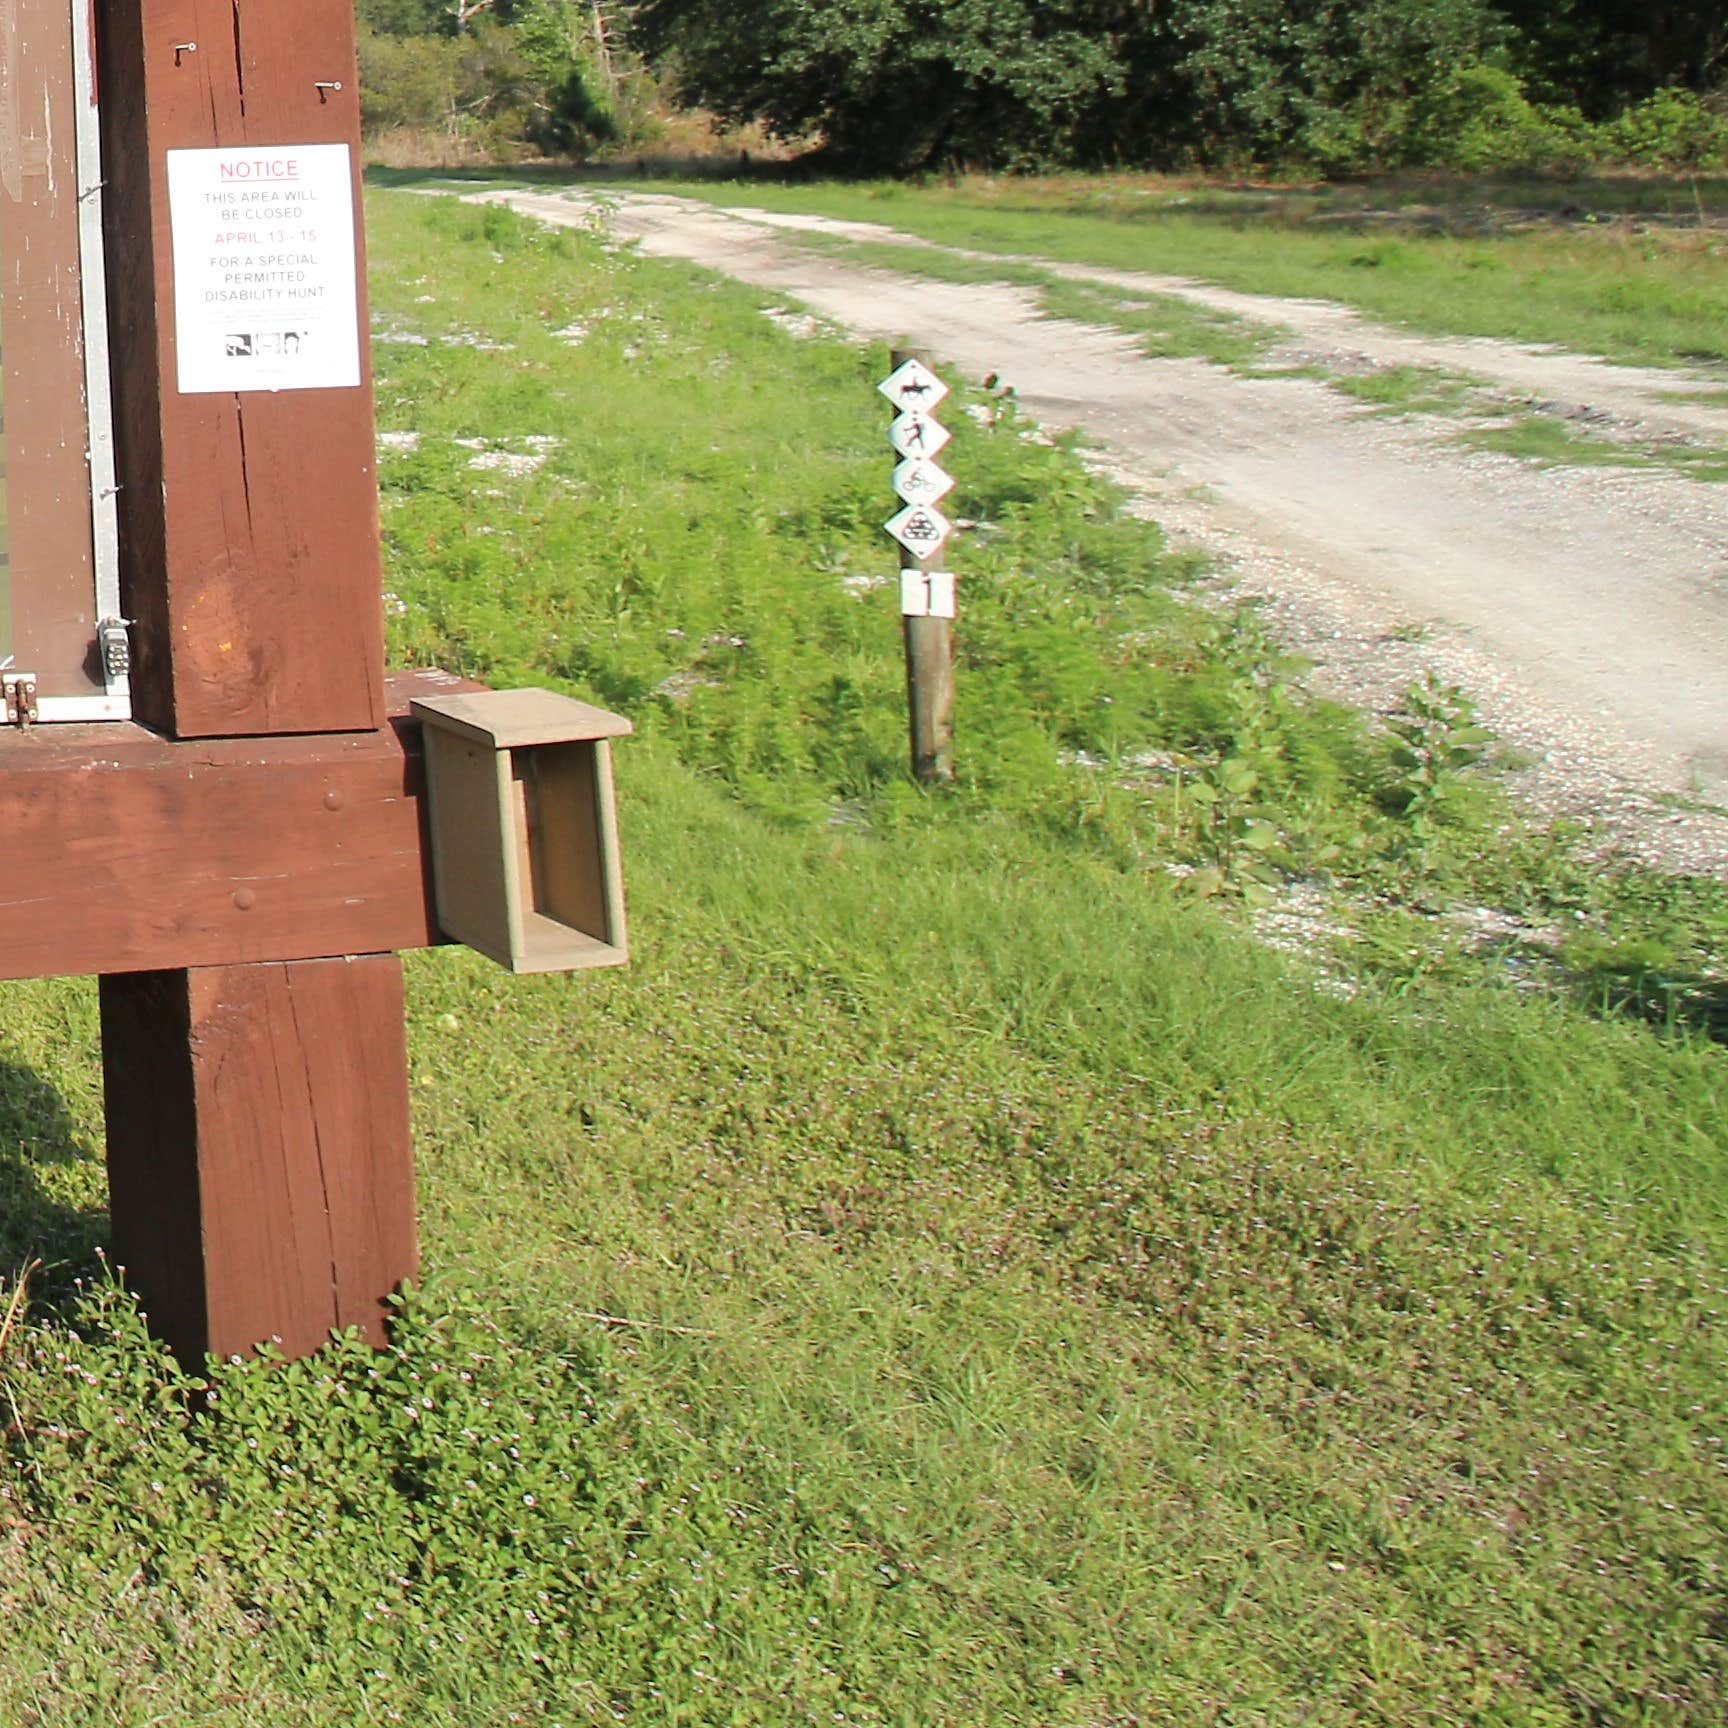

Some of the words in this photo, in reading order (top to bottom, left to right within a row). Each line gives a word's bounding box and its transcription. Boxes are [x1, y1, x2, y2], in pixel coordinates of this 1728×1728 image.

[220, 160, 299, 178] NOTICE
[205, 192, 236, 204] THIS
[241, 191, 280, 203] AREA
[285, 190, 318, 201] WILL
[221, 209, 239, 221] BE
[245, 207, 303, 220] CLOSED
[215, 231, 262, 244] APRIL
[210, 256, 239, 268] FOR
[244, 256, 253, 267] A
[258, 254, 318, 266] SPECIAL
[224, 271, 305, 284] PERMITTED
[204, 288, 283, 303] DISABILITY
[288, 286, 325, 299] HUNT
